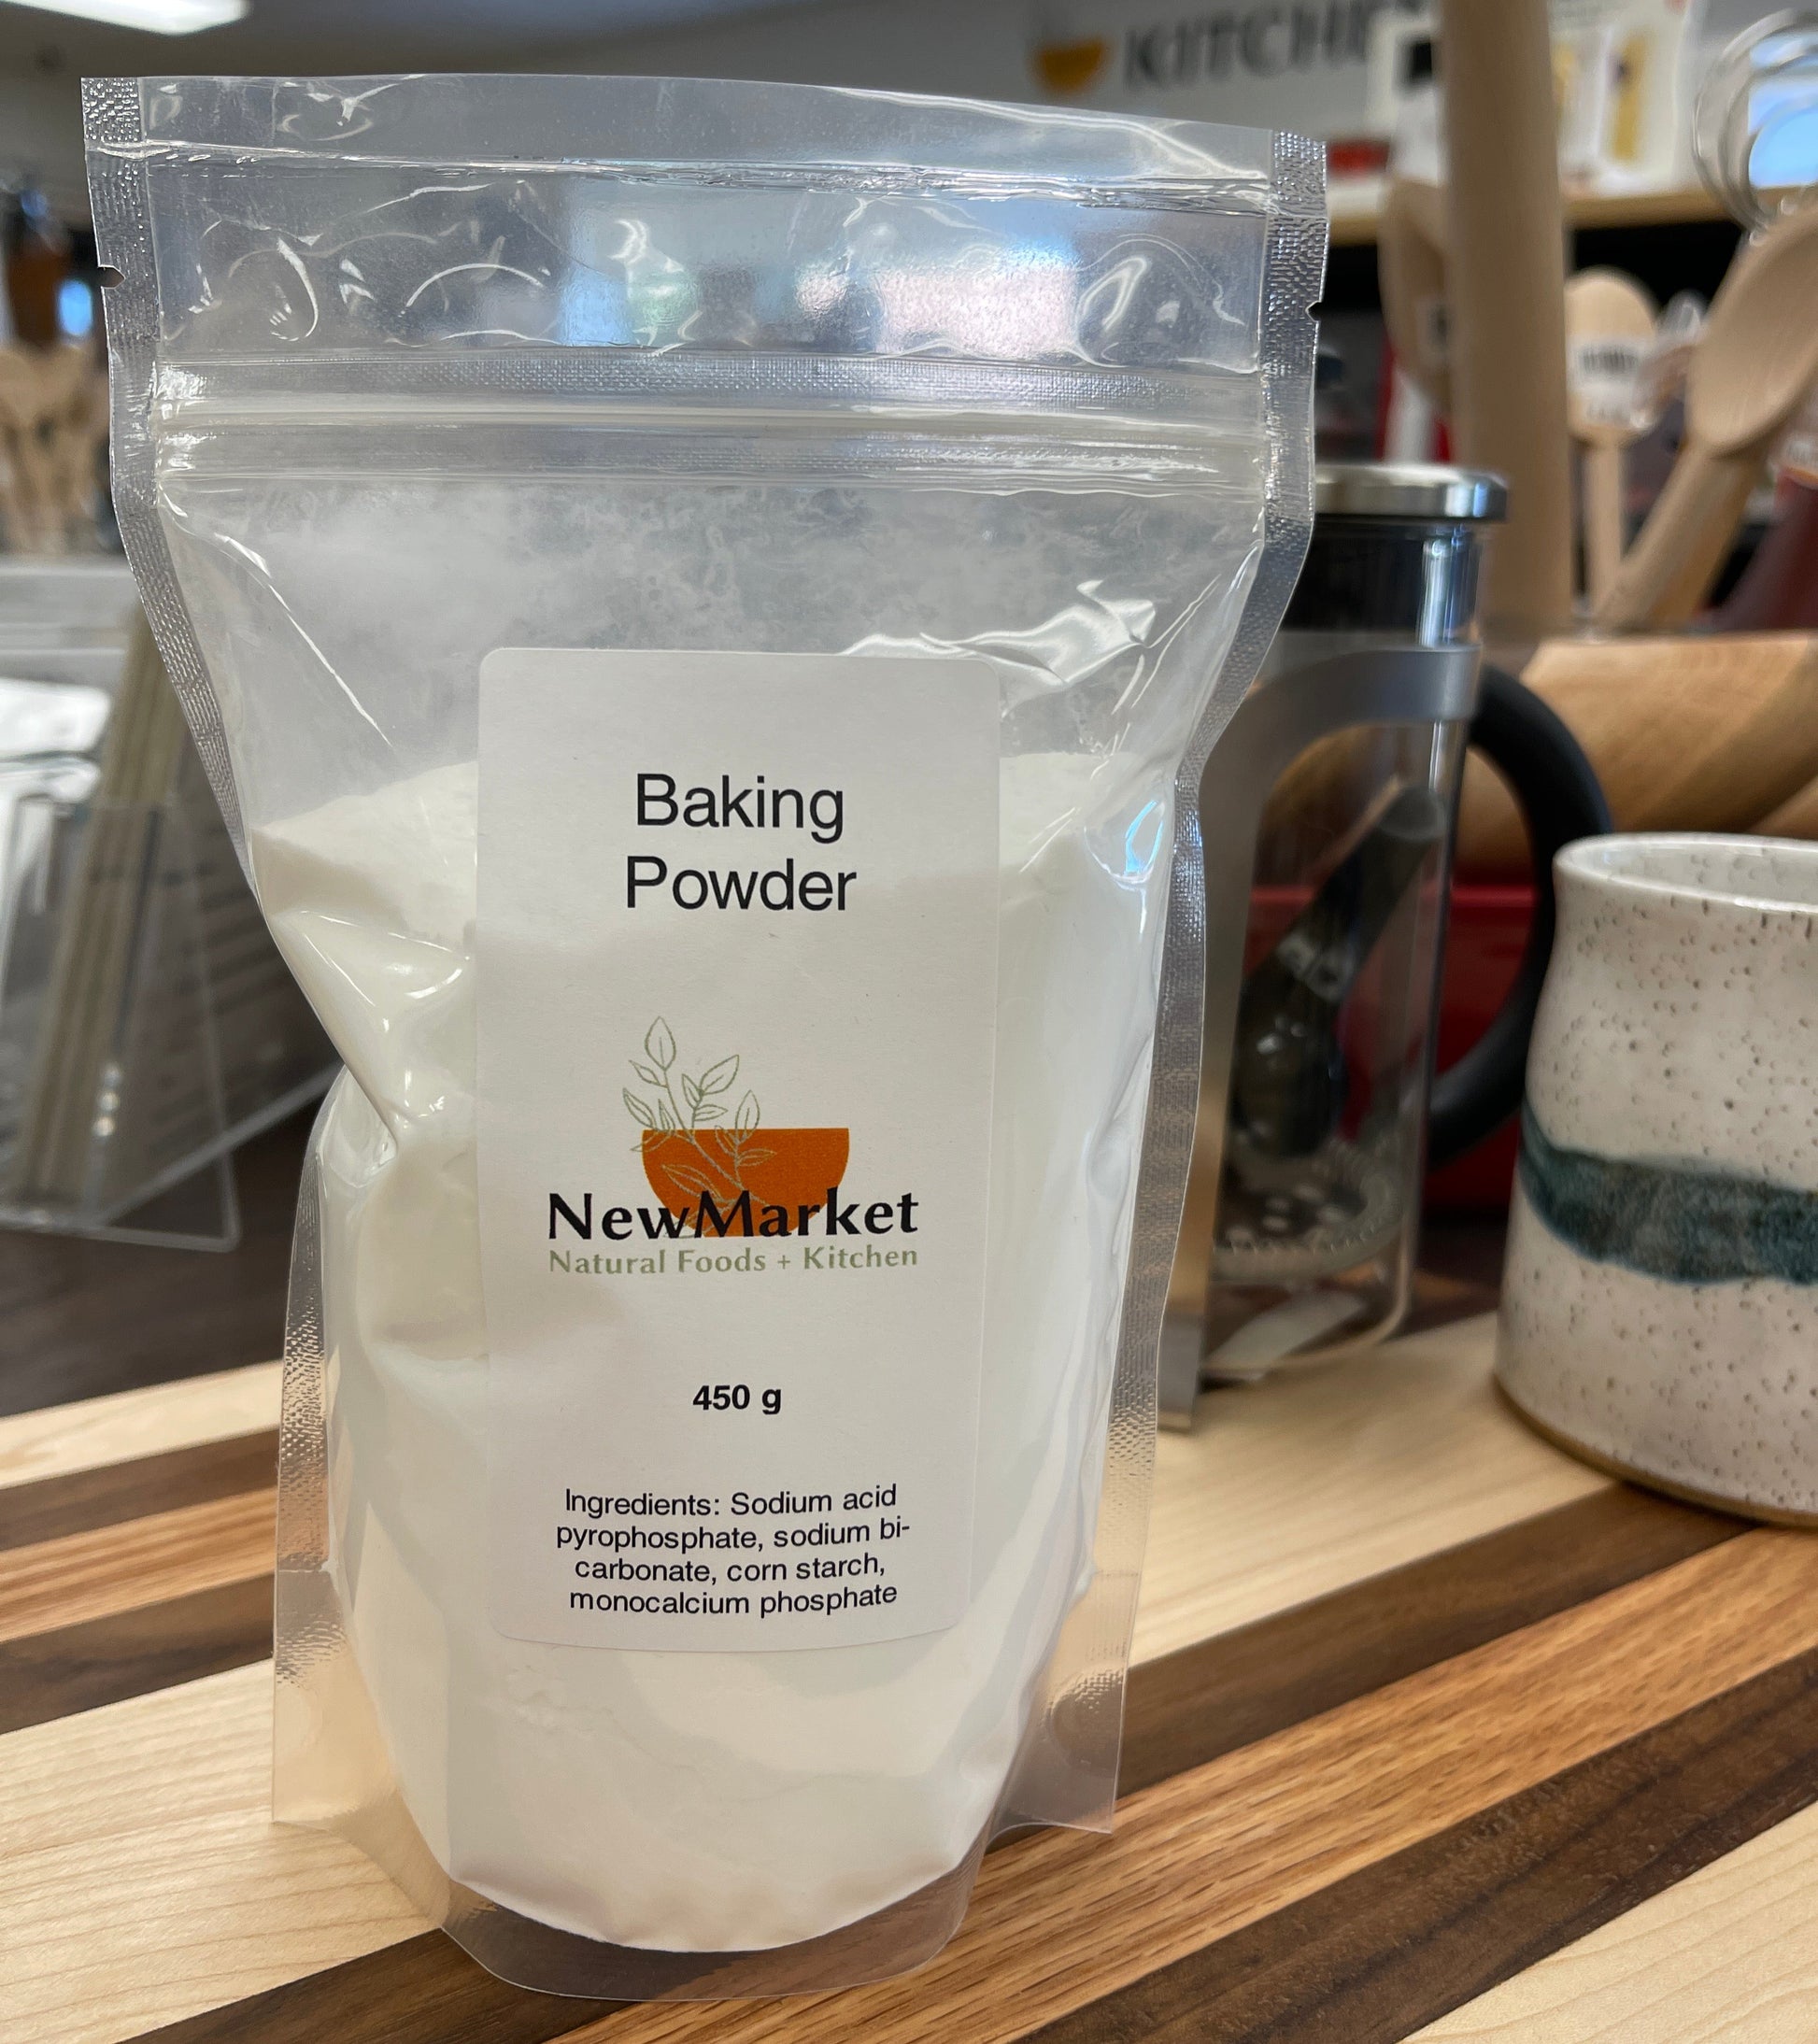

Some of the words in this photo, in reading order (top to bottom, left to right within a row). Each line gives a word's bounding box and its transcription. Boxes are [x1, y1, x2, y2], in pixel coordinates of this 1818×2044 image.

[637, 774, 843, 844] Baking
[628, 856, 857, 911] Powder
[549, 1186, 917, 1240] NewMarket
[550, 1250, 665, 1274] Natural
[679, 1247, 765, 1272] Foods
[777, 1255, 790, 1270] +
[804, 1244, 916, 1270] Kitchen
[693, 1384, 750, 1411] 450
[762, 1389, 781, 1415] g
[566, 1488, 719, 1519] Ingredients:
[731, 1491, 831, 1515] Sodium
[844, 1483, 896, 1511] acid
[557, 1526, 762, 1554] pyrophosphate,
[774, 1523, 870, 1547] sodium
[880, 1515, 910, 1540] bi-
[575, 1558, 716, 1585] carbonate,
[727, 1564, 787, 1582] corn
[796, 1553, 884, 1580] starch,
[571, 1592, 749, 1614] monocalcium
[760, 1584, 897, 1619] phosphate
